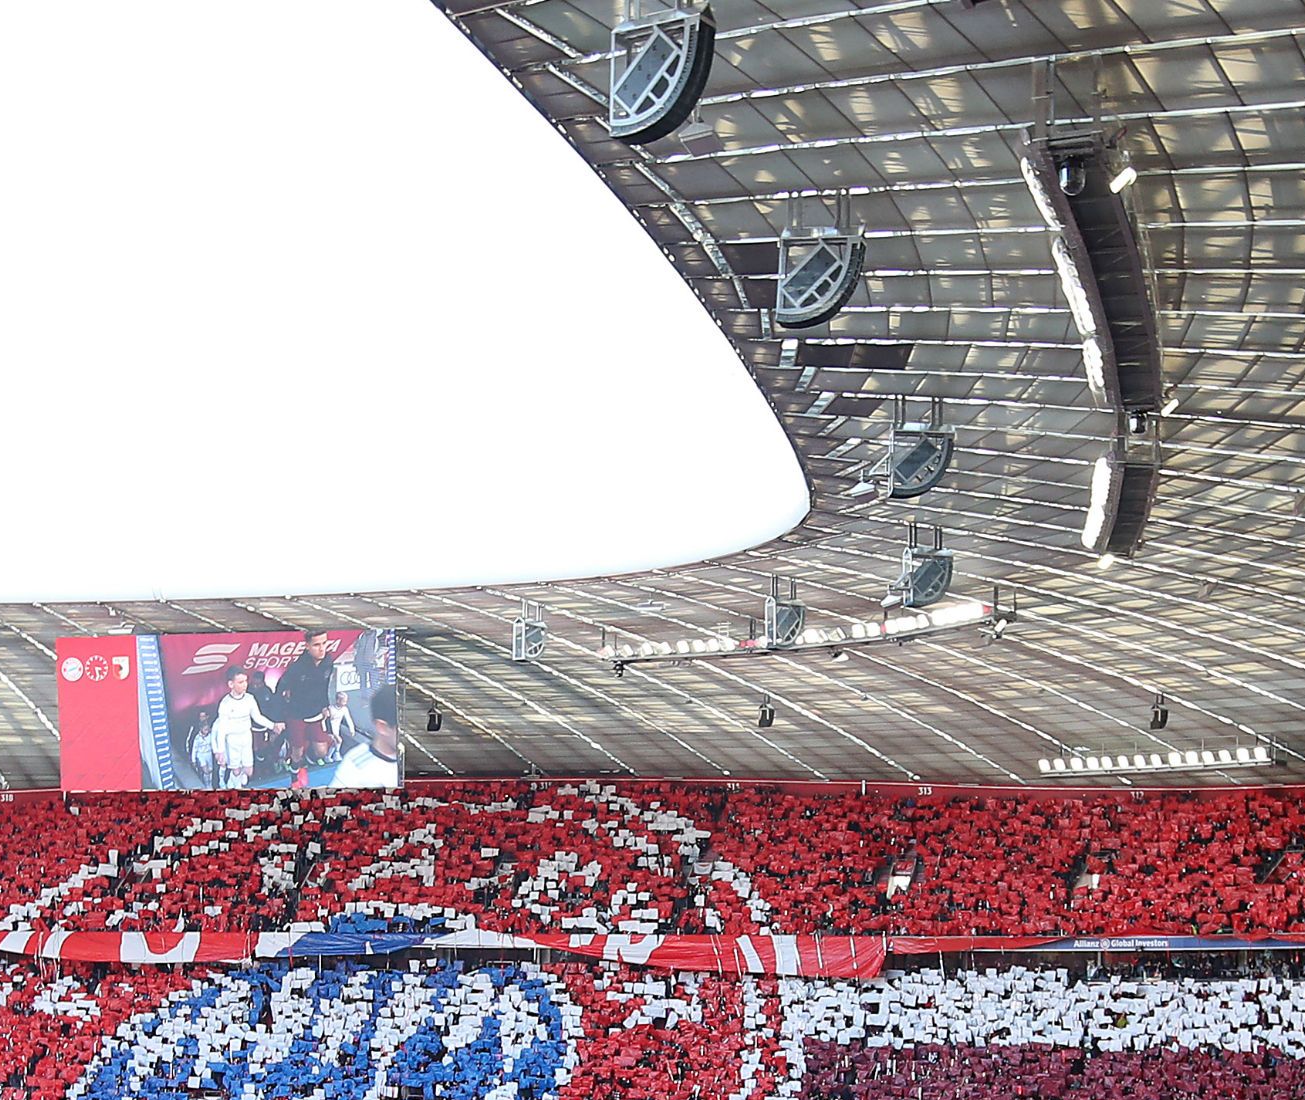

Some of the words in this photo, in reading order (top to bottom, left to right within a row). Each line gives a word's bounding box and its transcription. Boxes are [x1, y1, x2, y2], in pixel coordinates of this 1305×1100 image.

[248, 639, 342, 657] MAGETA
[918, 787, 932, 796] 313
[0, 794, 14, 803] 318
[1073, 940, 1099, 948] Allianz
